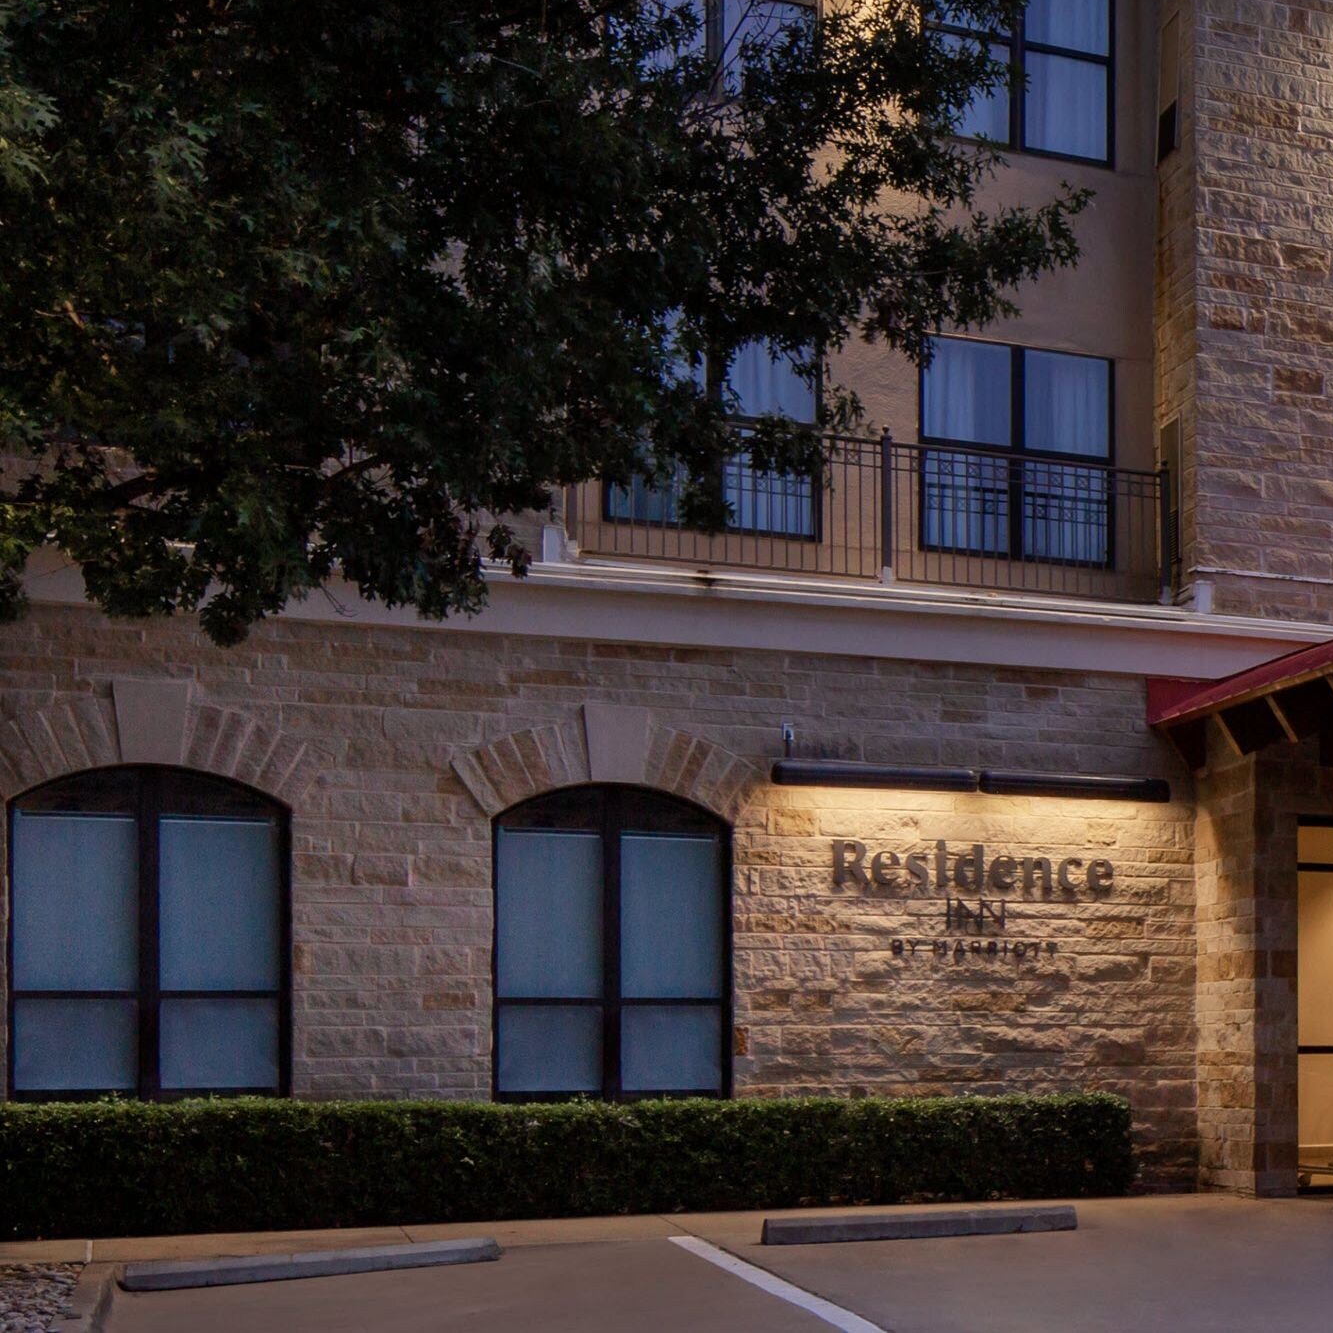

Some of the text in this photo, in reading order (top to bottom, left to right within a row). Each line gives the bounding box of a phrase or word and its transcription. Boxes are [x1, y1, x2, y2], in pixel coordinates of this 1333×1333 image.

[831, 839, 1114, 891] Residence
[946, 897, 1006, 931] INN
[891, 938, 1058, 958] BY MARRIOTT
